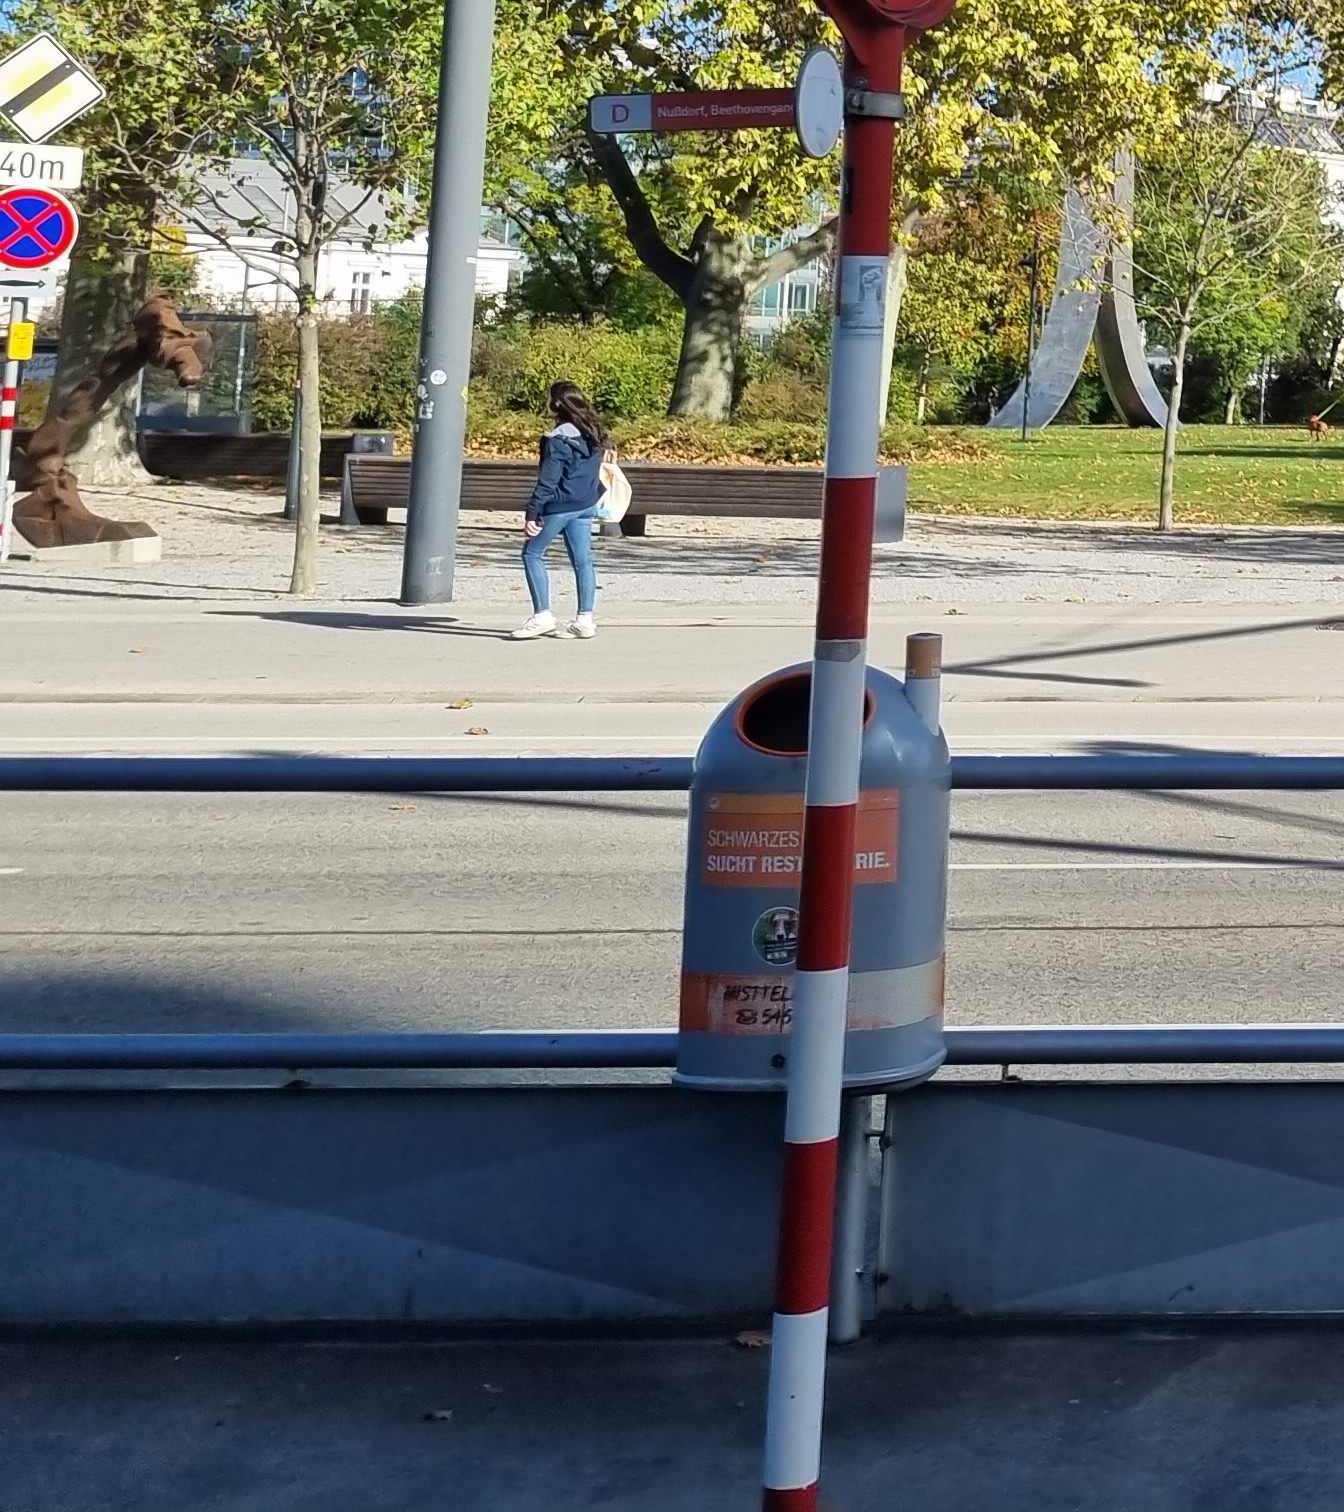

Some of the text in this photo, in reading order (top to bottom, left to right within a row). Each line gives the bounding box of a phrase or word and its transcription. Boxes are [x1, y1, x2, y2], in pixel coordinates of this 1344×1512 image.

[611, 103, 630, 124] D
[0, 151, 65, 181] 40m
[707, 829, 801, 849] SCHWARZES
[706, 854, 757, 873] SUCHT
